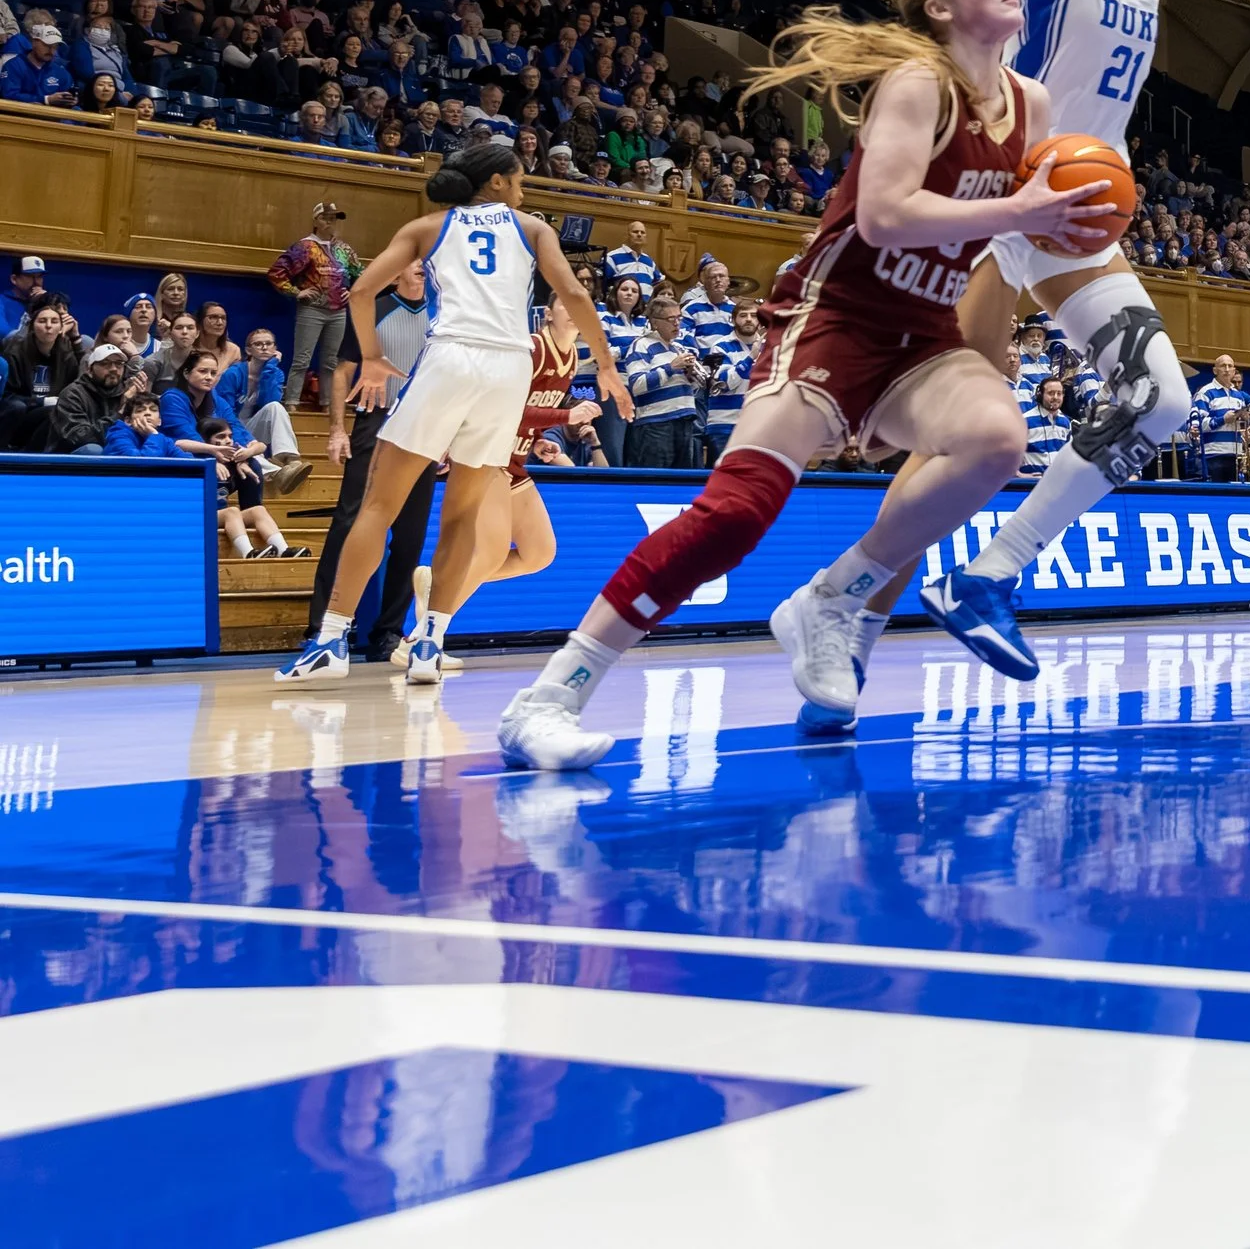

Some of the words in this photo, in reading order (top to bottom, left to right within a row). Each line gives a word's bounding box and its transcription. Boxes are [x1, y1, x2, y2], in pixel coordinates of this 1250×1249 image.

[1097, 45, 1145, 102] 21
[468, 230, 496, 275] 3
[874, 245, 968, 306] COLLEG
[0, 547, 74, 584] alth
